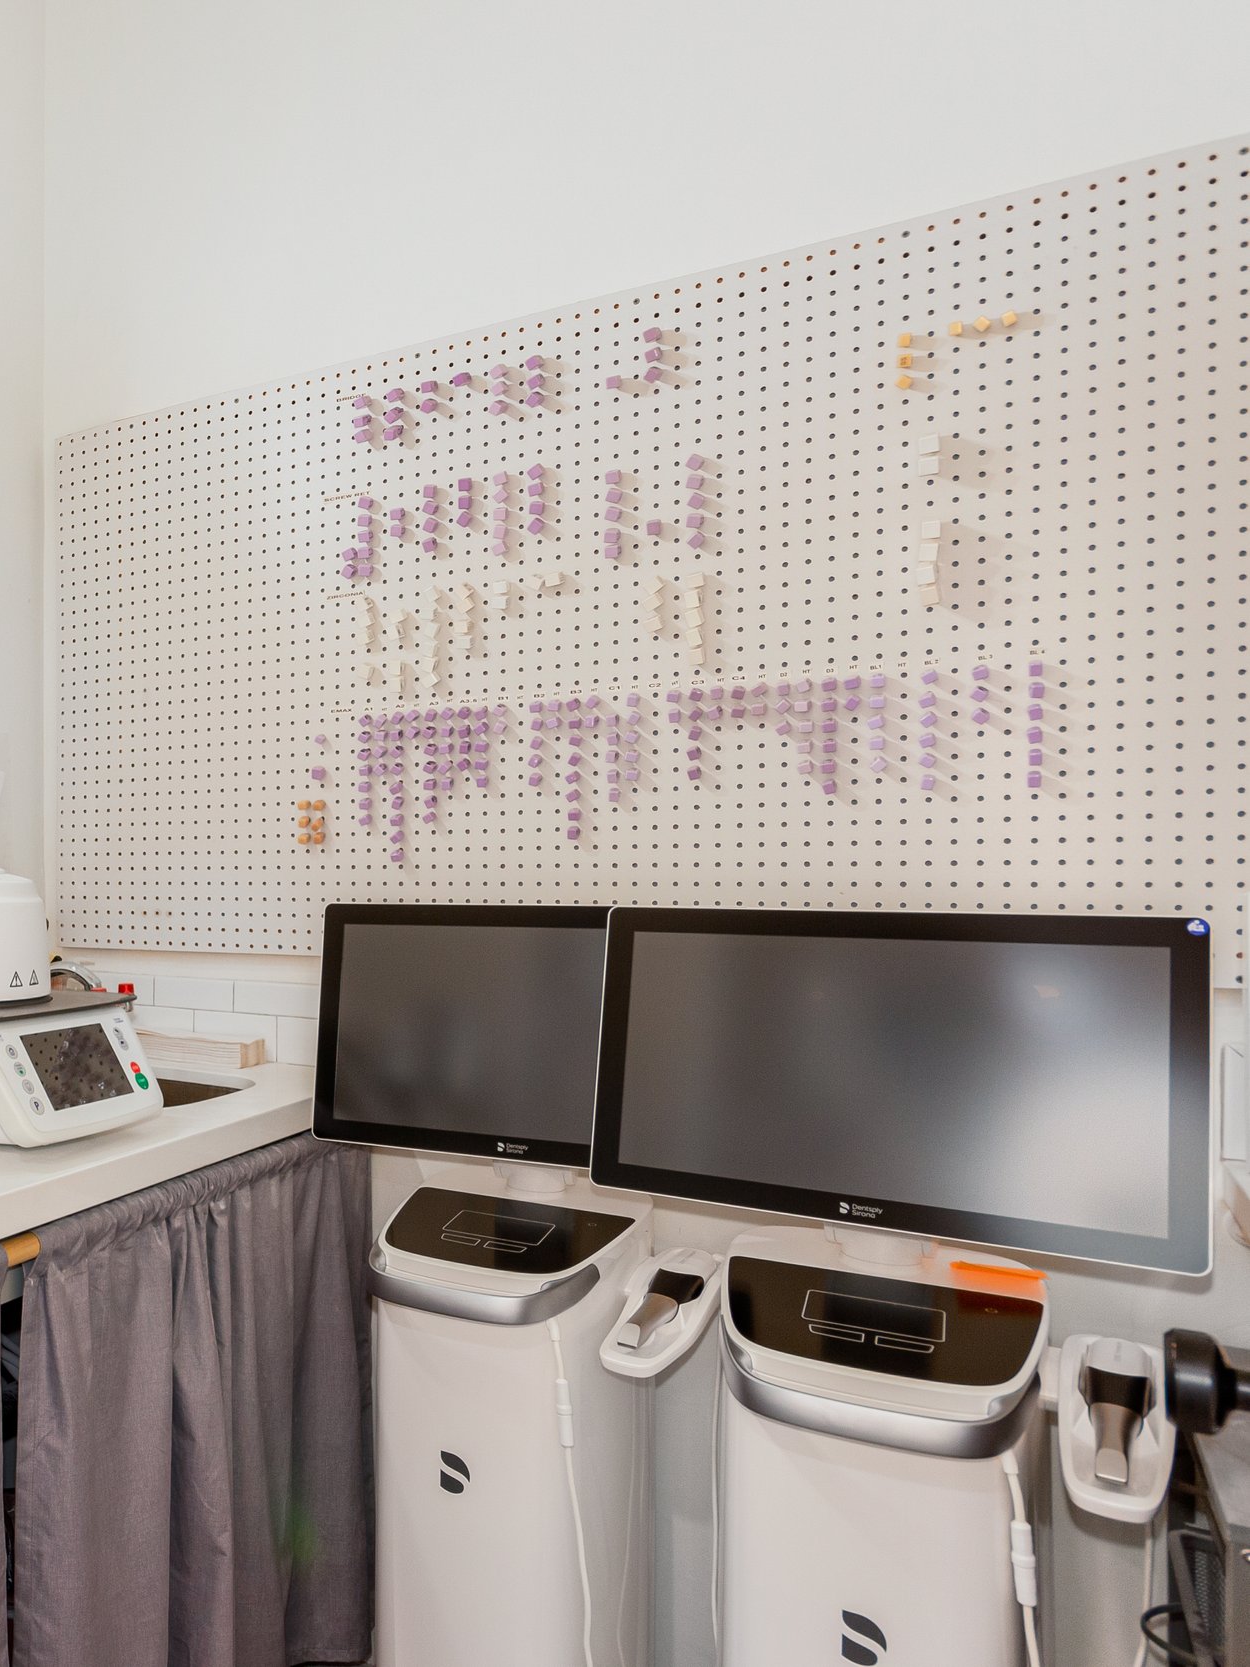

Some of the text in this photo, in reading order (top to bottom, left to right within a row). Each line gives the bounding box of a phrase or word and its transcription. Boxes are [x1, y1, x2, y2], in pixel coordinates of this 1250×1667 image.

[336, 393, 367, 403] BRIDGE
[324, 493, 353, 502] SCREW
[326, 591, 364, 601] ZIRCONIA
[505, 1142, 529, 1152] Dentsply
[506, 1147, 524, 1155] Sirona
[851, 1203, 884, 1215] Dentsply
[851, 1209, 876, 1219] Sirona
